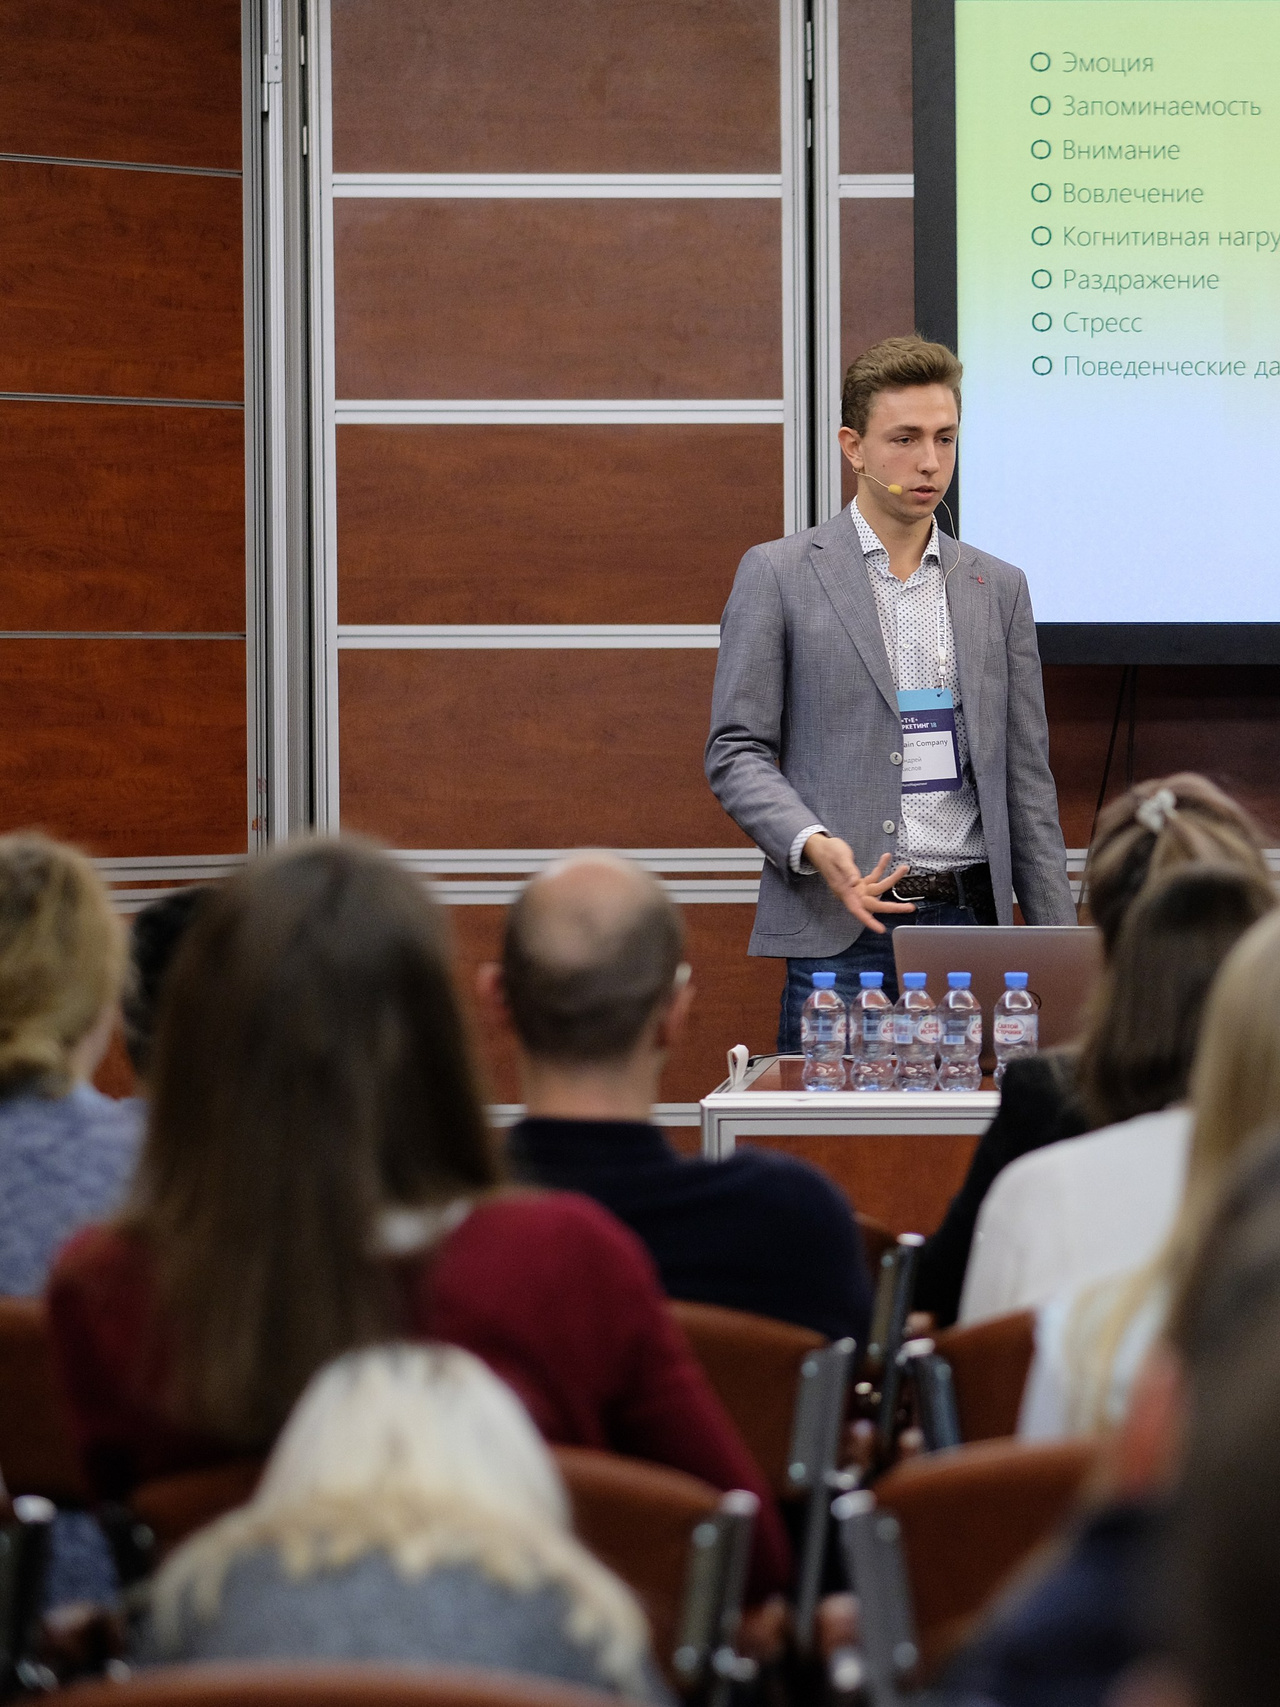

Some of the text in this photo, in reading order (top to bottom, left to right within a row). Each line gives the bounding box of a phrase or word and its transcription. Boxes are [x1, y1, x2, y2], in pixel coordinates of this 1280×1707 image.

[1062, 51, 1154, 77] Эмоция
[1062, 94, 1262, 117] Запоминаемость
[1062, 138, 1181, 161] Внимание
[1062, 182, 1205, 204] Вовлечение
[1062, 225, 1209, 247] Когнитивная
[1062, 268, 1220, 295] Раздражение
[1062, 311, 1143, 338] Стресс
[1063, 355, 1246, 380] Поведенческие
[902, 722, 929, 730] РКЕТИНГ
[916, 739, 948, 748] Company
